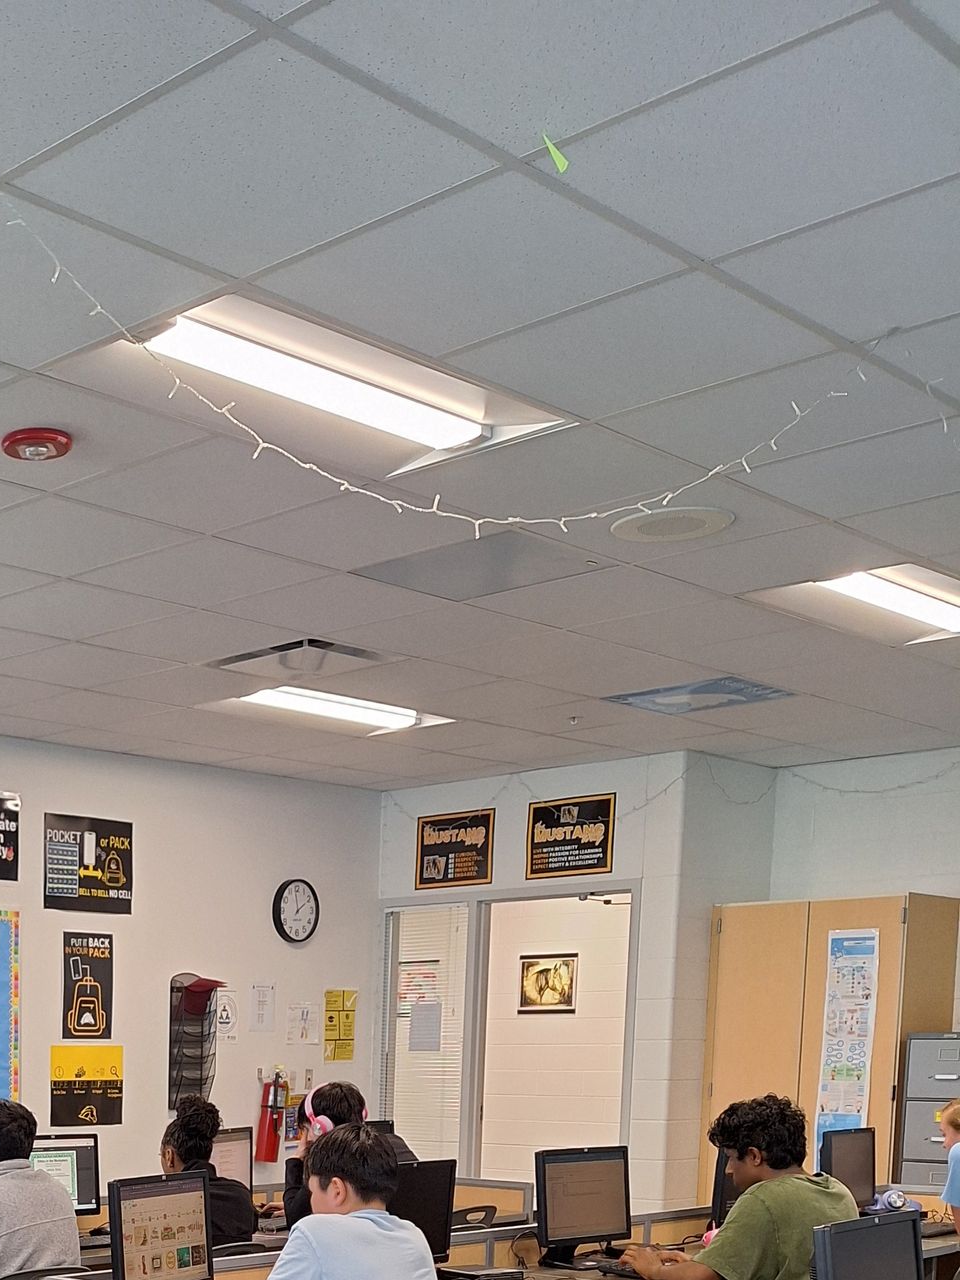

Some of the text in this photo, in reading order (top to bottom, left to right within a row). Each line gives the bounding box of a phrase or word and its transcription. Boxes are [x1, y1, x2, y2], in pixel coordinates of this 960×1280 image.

[534, 823, 604, 843] MUSTANG
[47, 829, 130, 849] POCKET or PACK
[568, 853, 603, 861] RELATIONSHIPS
[79, 887, 91, 896] BELL
[91, 889, 98, 897] TO
[109, 889, 118, 898] NO
[119, 890, 131, 899] CELL
[71, 938, 110, 948] PUT IT BACK
[72, 947, 88, 955] YOUR
[89, 948, 110, 958] PACK
